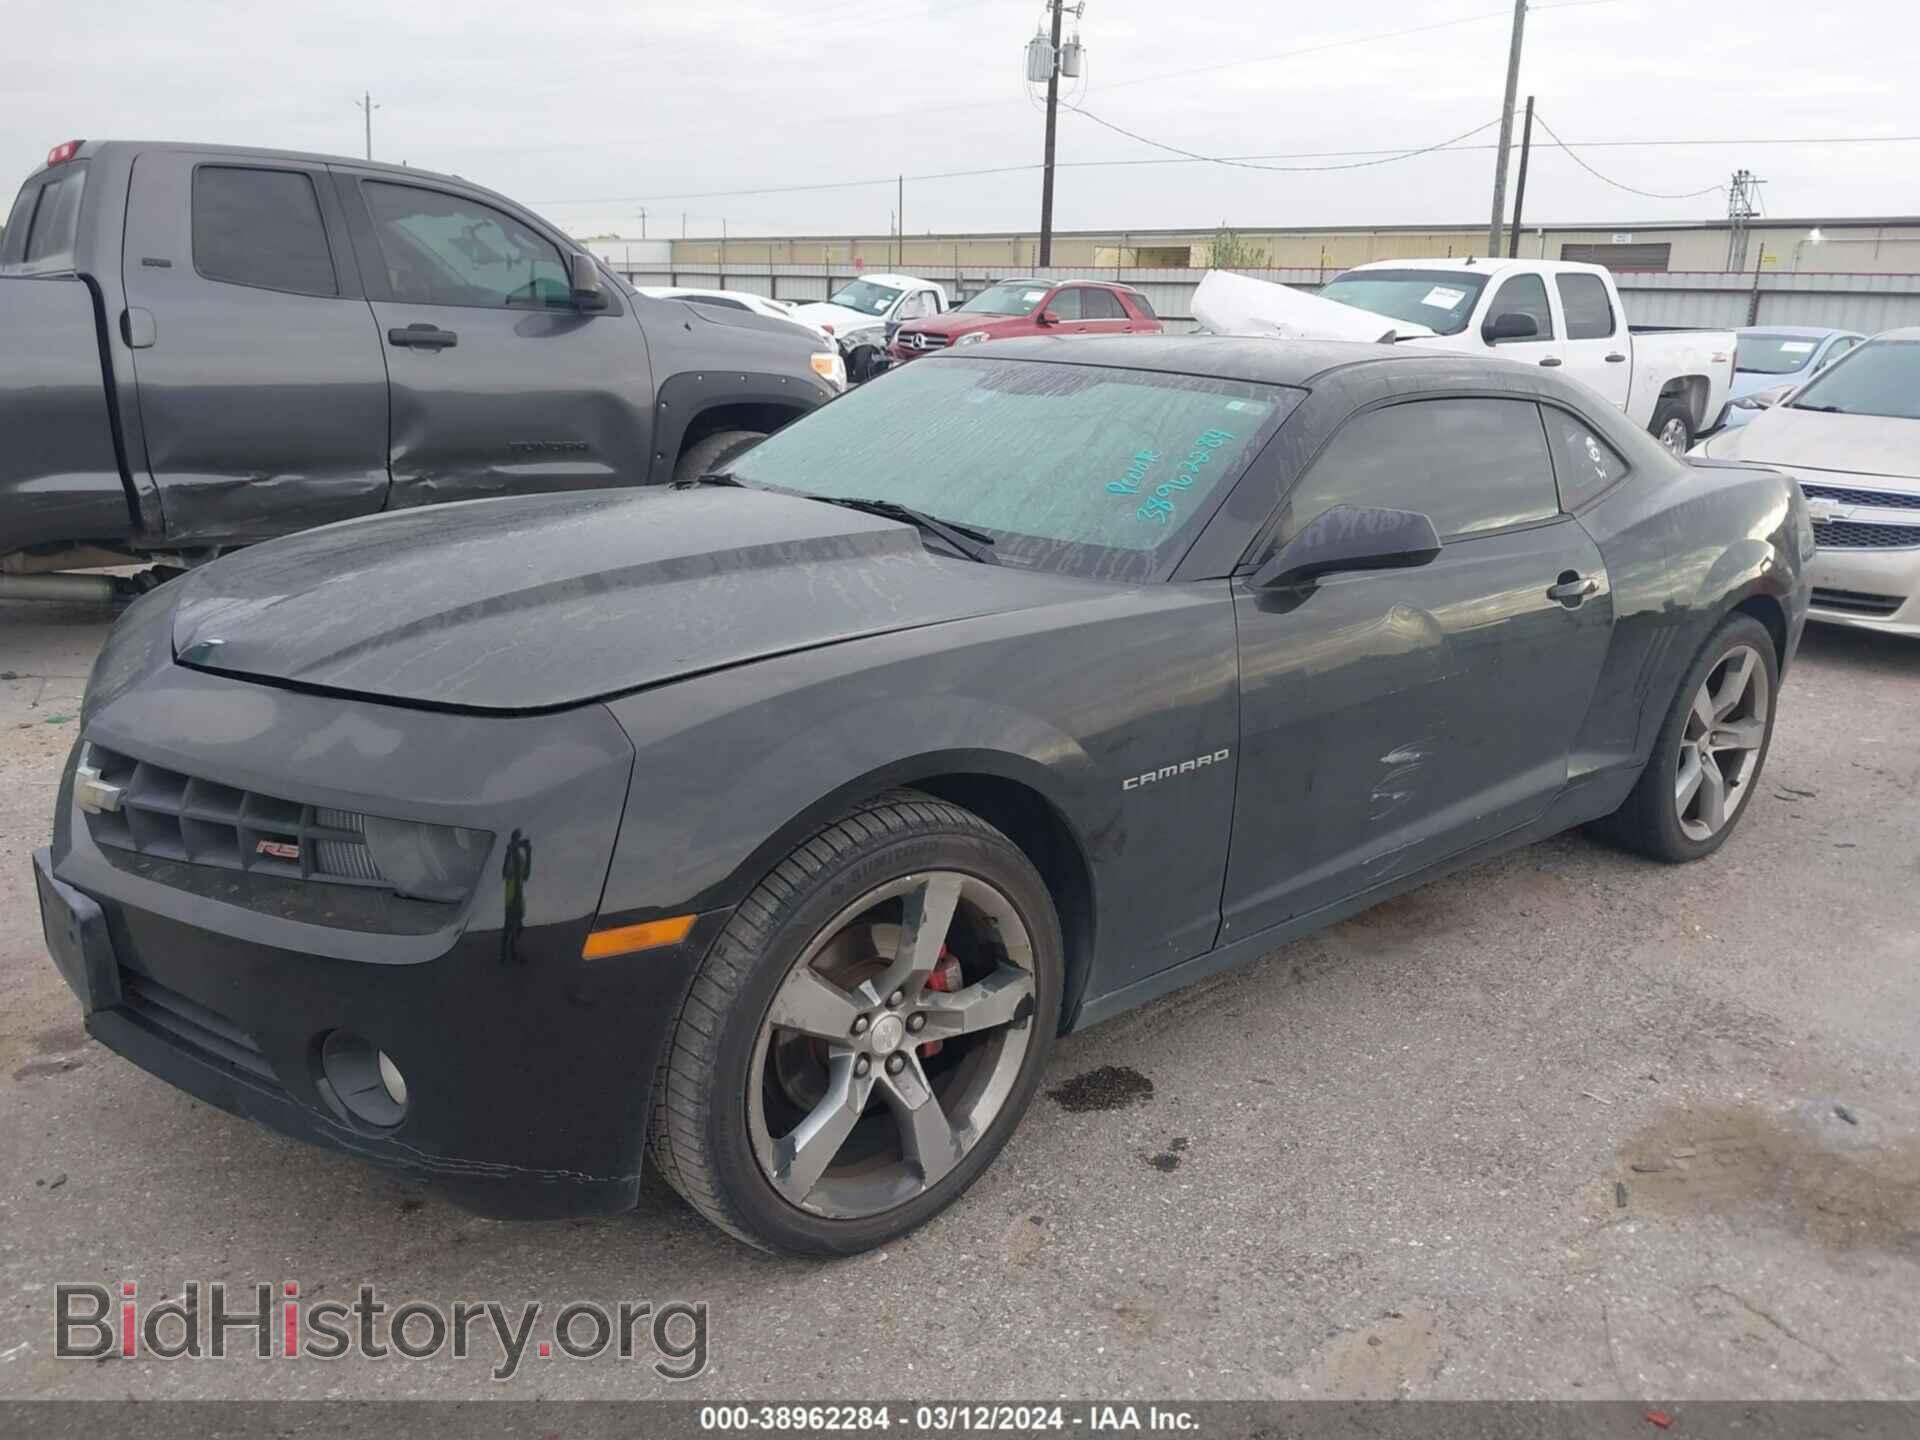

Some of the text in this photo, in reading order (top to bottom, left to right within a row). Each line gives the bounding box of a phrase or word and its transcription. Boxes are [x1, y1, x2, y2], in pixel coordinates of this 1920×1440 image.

[1136, 428, 1236, 524] 38962284
[1122, 748, 1230, 791] CAMARO
[255, 839, 300, 859] RS
